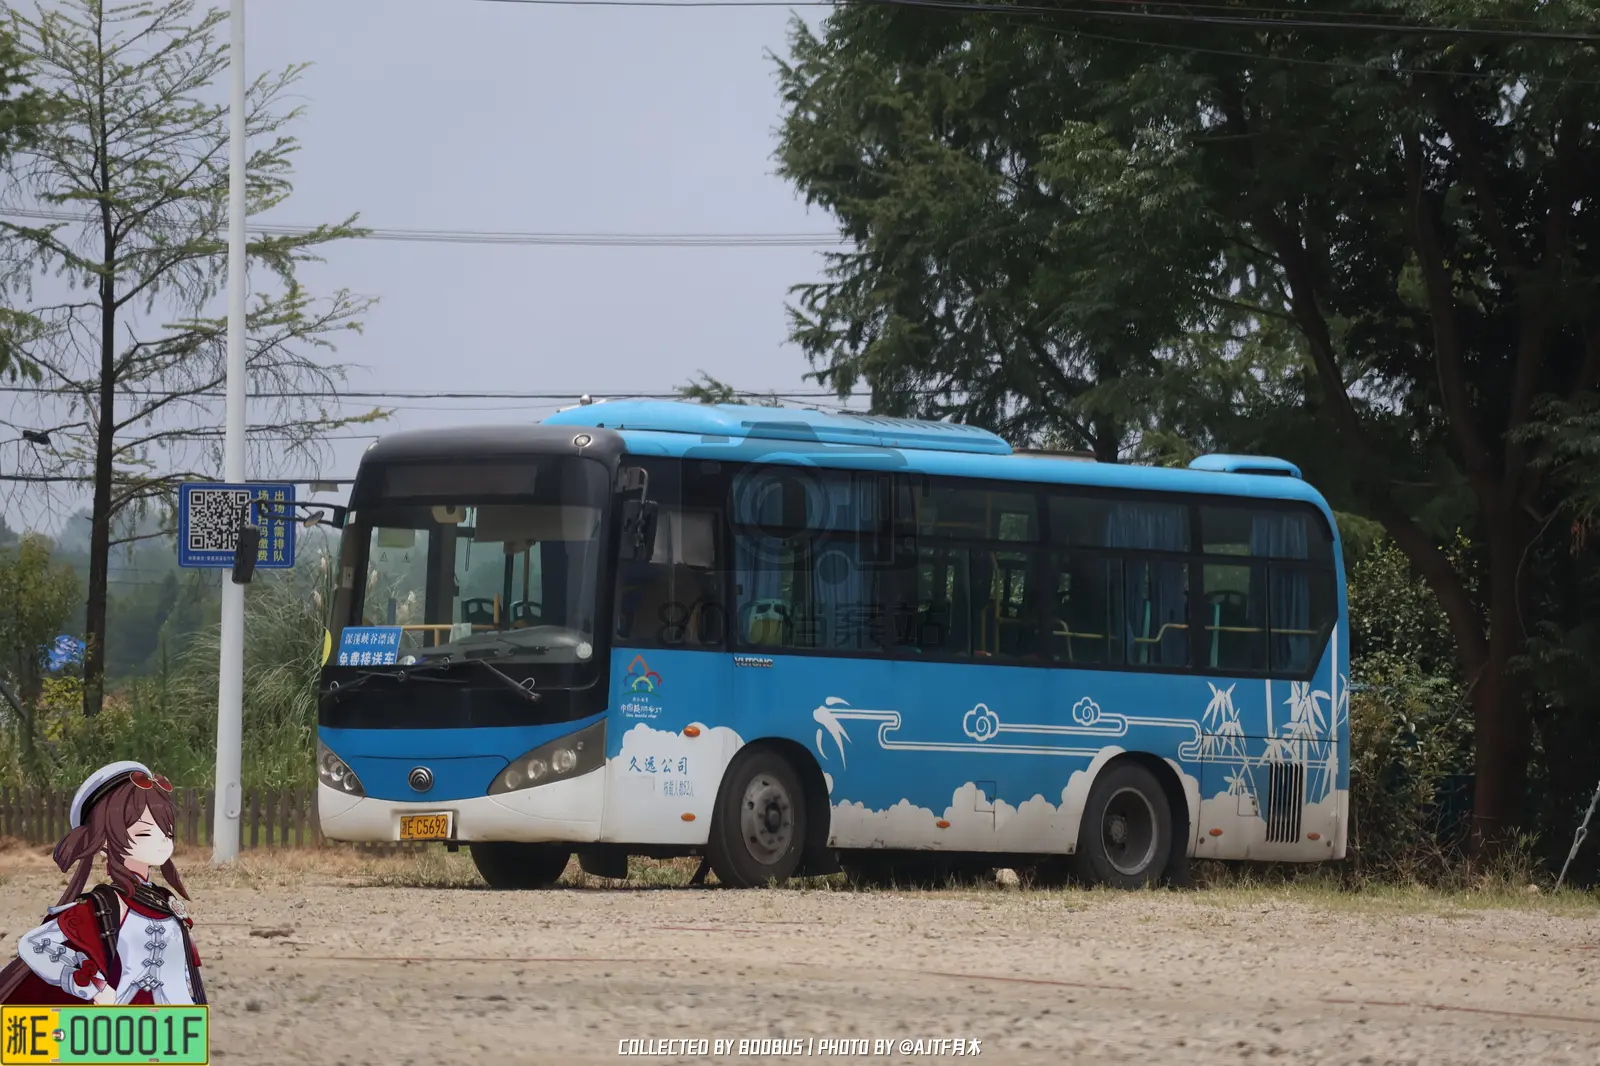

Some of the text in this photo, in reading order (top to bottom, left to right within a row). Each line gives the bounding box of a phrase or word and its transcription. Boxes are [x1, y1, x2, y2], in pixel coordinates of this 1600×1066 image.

[339, 651, 395, 666] 免费接送车
[629, 756, 688, 775] 久远公司
